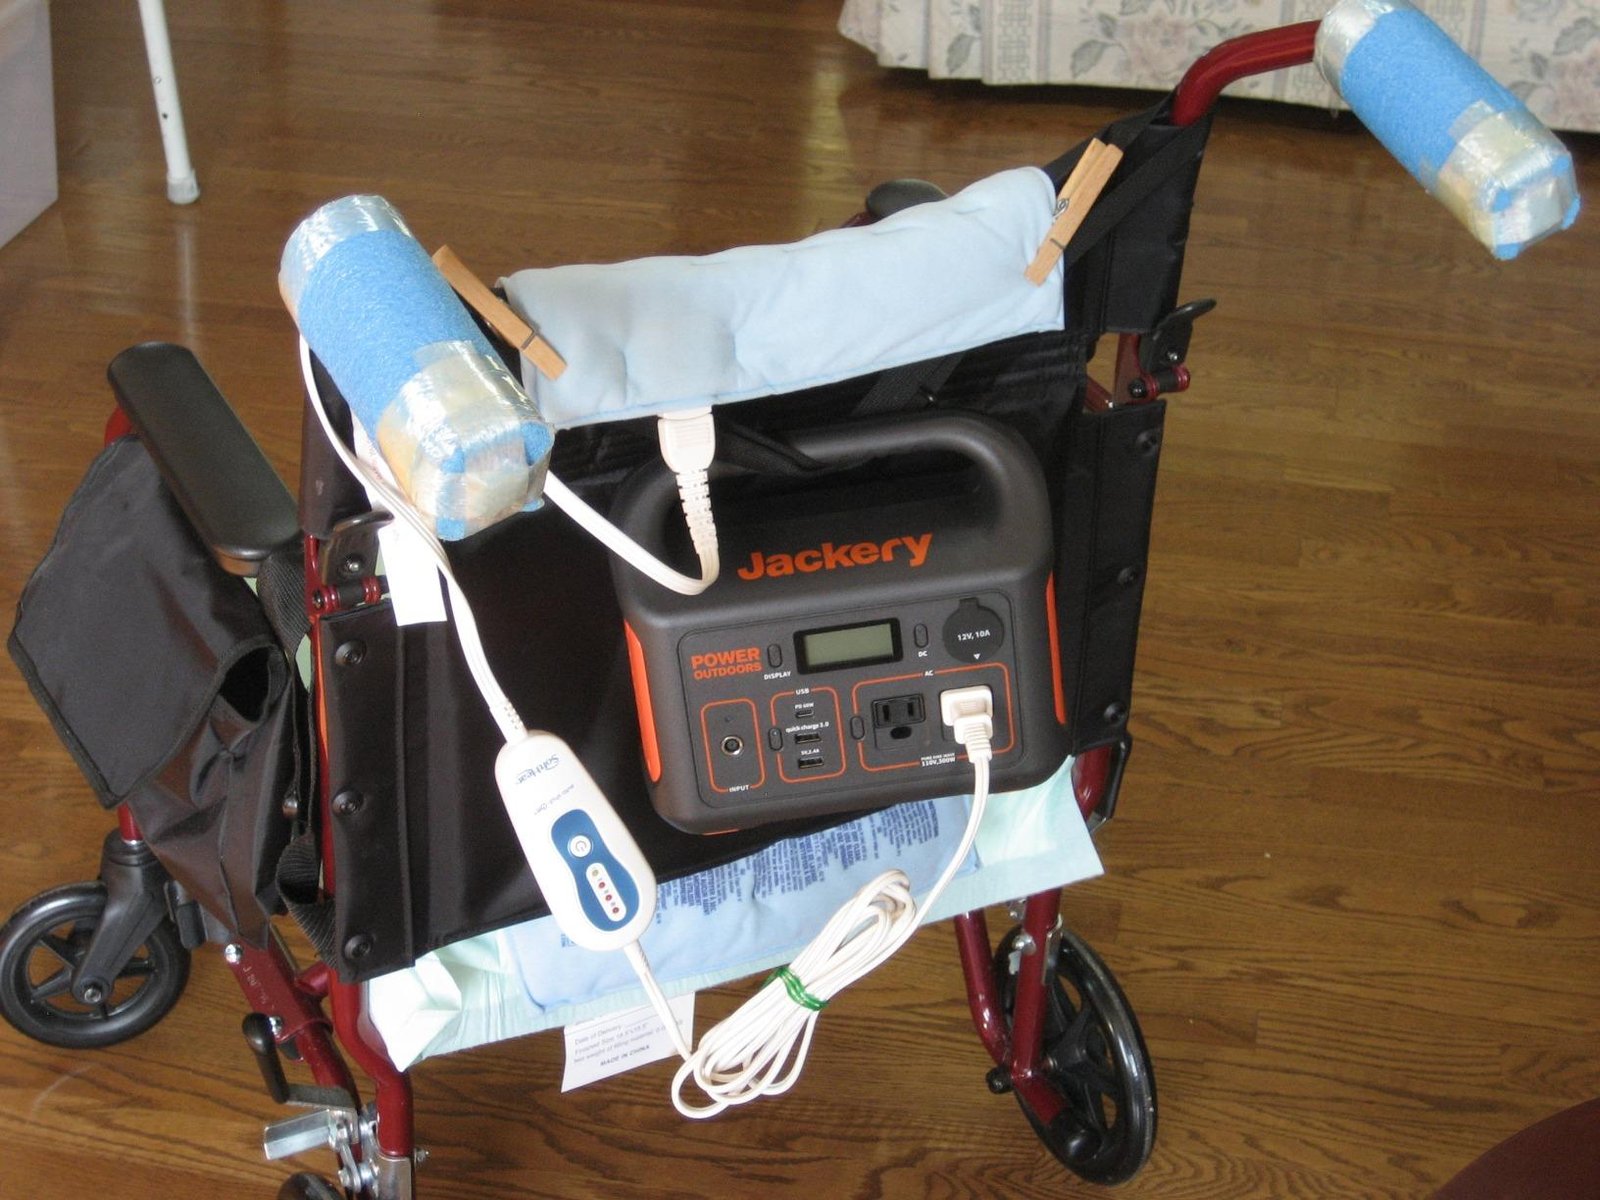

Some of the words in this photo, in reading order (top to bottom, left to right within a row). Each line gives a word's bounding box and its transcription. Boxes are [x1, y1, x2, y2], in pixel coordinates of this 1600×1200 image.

[737, 533, 933, 580] Jackery
[957, 632, 974, 641] 12V,
[975, 629, 991, 638] 10A
[691, 647, 760, 669] POWER
[918, 650, 928, 658] DC
[694, 662, 762, 680] OUTDOORS
[763, 671, 791, 680] DISPLAY
[729, 784, 750, 793] INPUT
[600, 1055, 620, 1066] MADE
